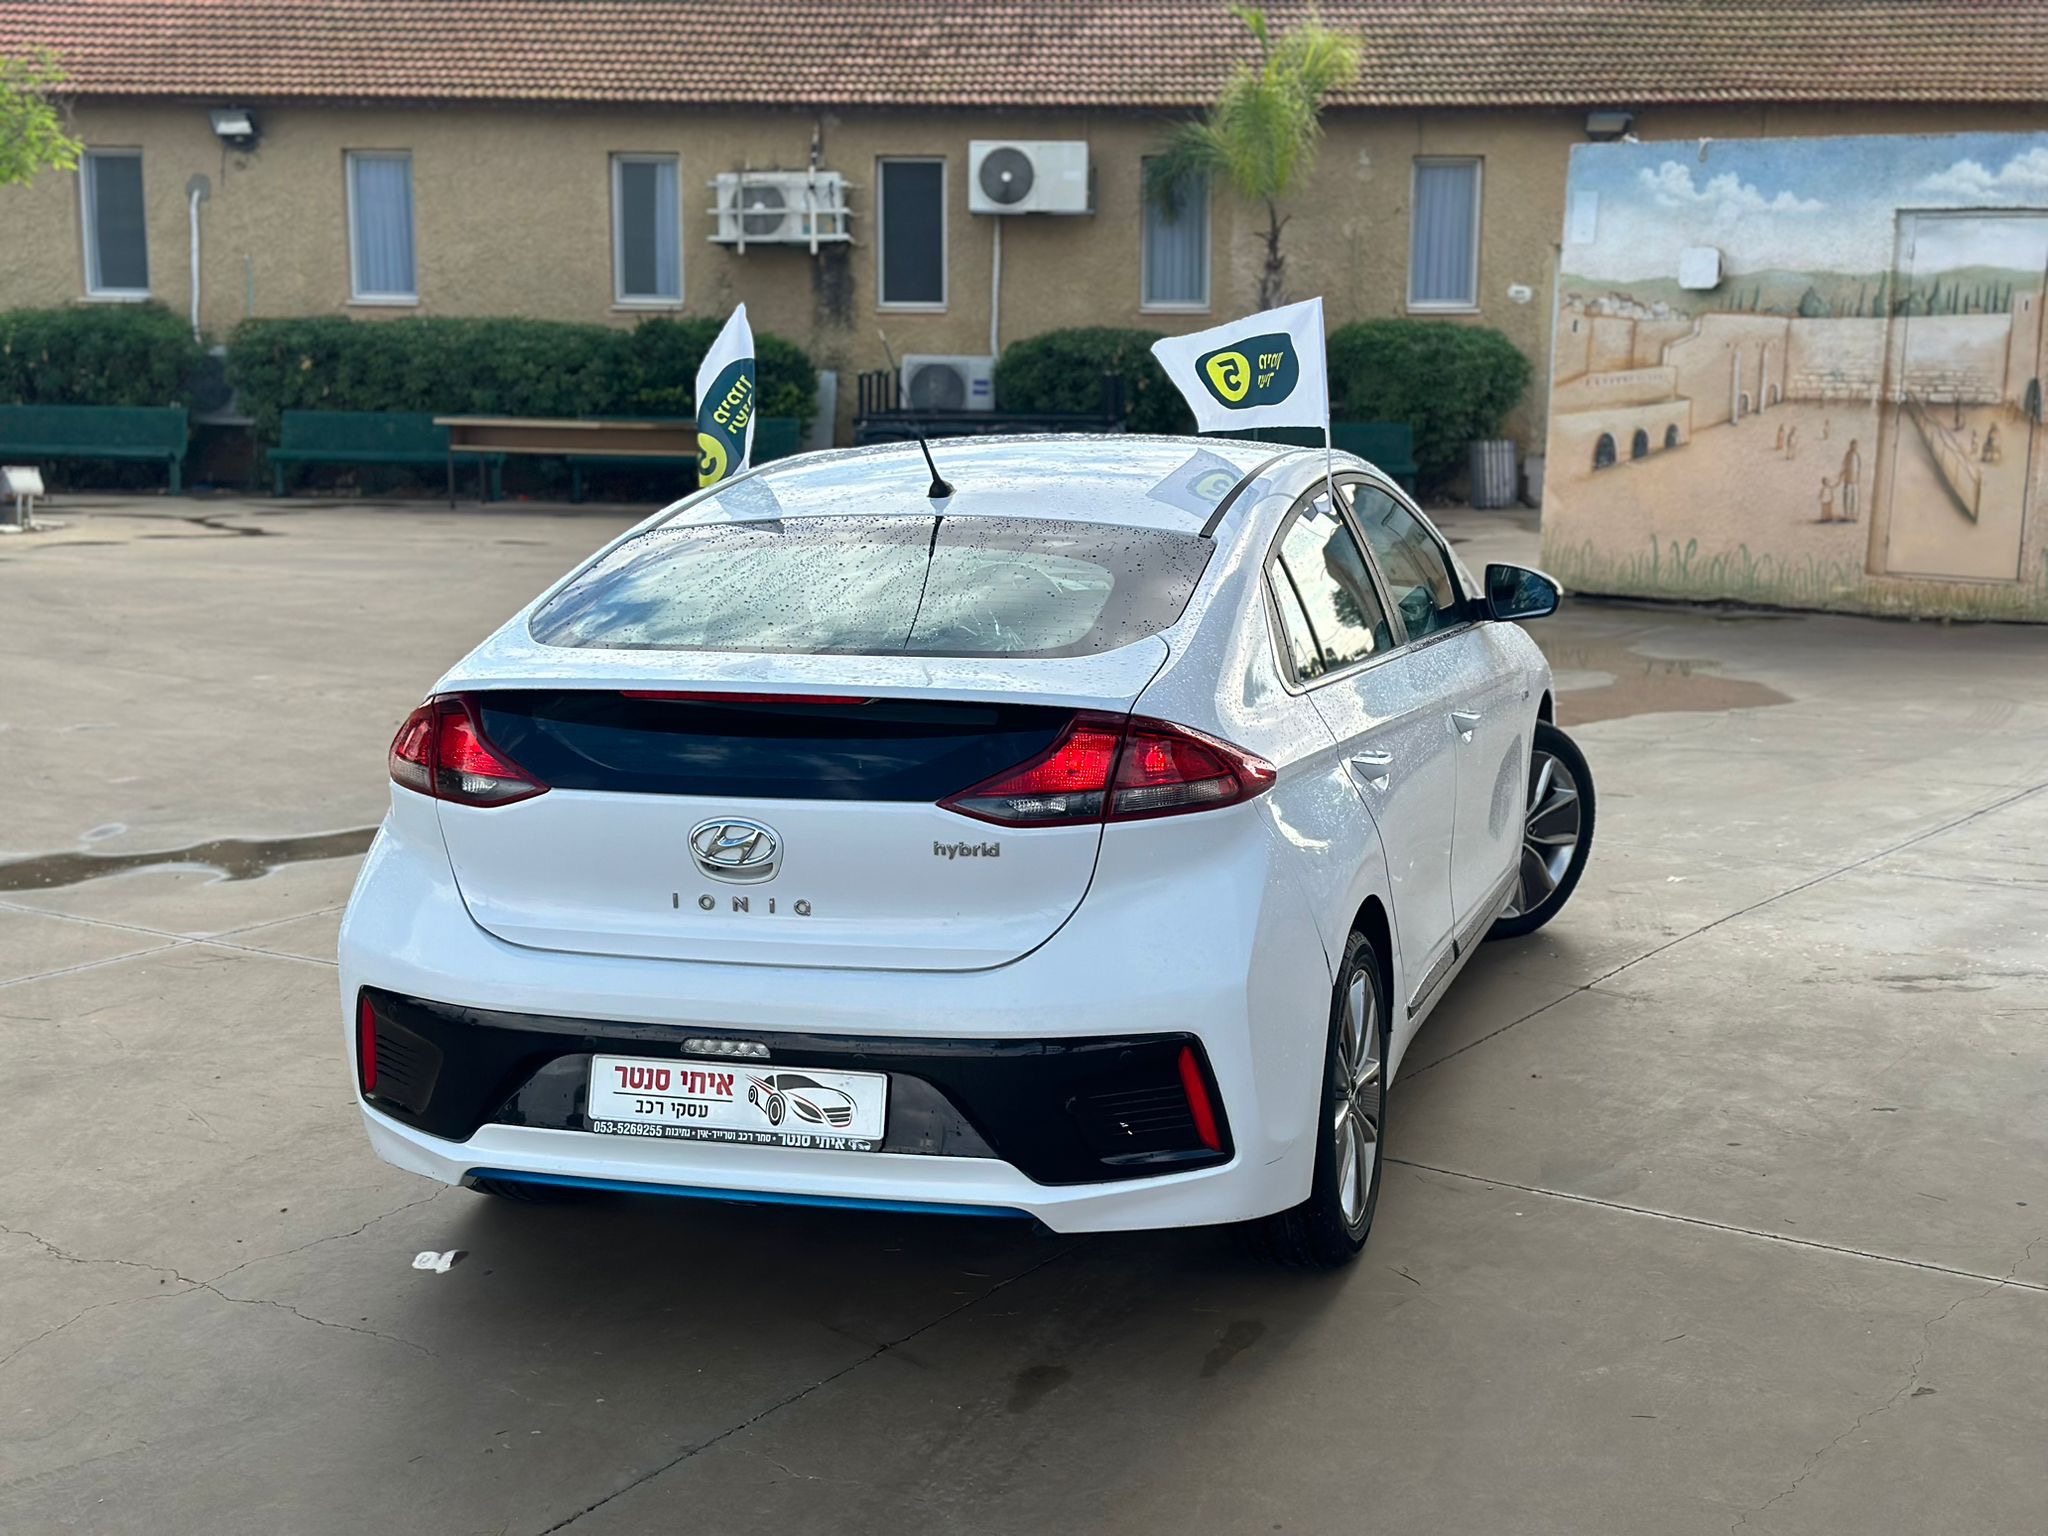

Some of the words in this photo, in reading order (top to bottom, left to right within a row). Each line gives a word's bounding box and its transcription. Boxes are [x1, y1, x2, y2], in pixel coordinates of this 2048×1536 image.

[933, 840, 1001, 860] hybrid
[672, 892, 812, 917] IONIQ
[614, 1065, 671, 1091] סנטר
[681, 1070, 734, 1097] איתי
[635, 1099, 664, 1115] רכב
[671, 1101, 709, 1119] עסקי
[593, 1120, 663, 1137] 053-5269255
[665, 1127, 691, 1137] נתיבות
[737, 1131, 753, 1142] רכב
[755, 1133, 771, 1143] סחר
[778, 1133, 811, 1147] סנטר
[815, 1135, 846, 1150] איתי
